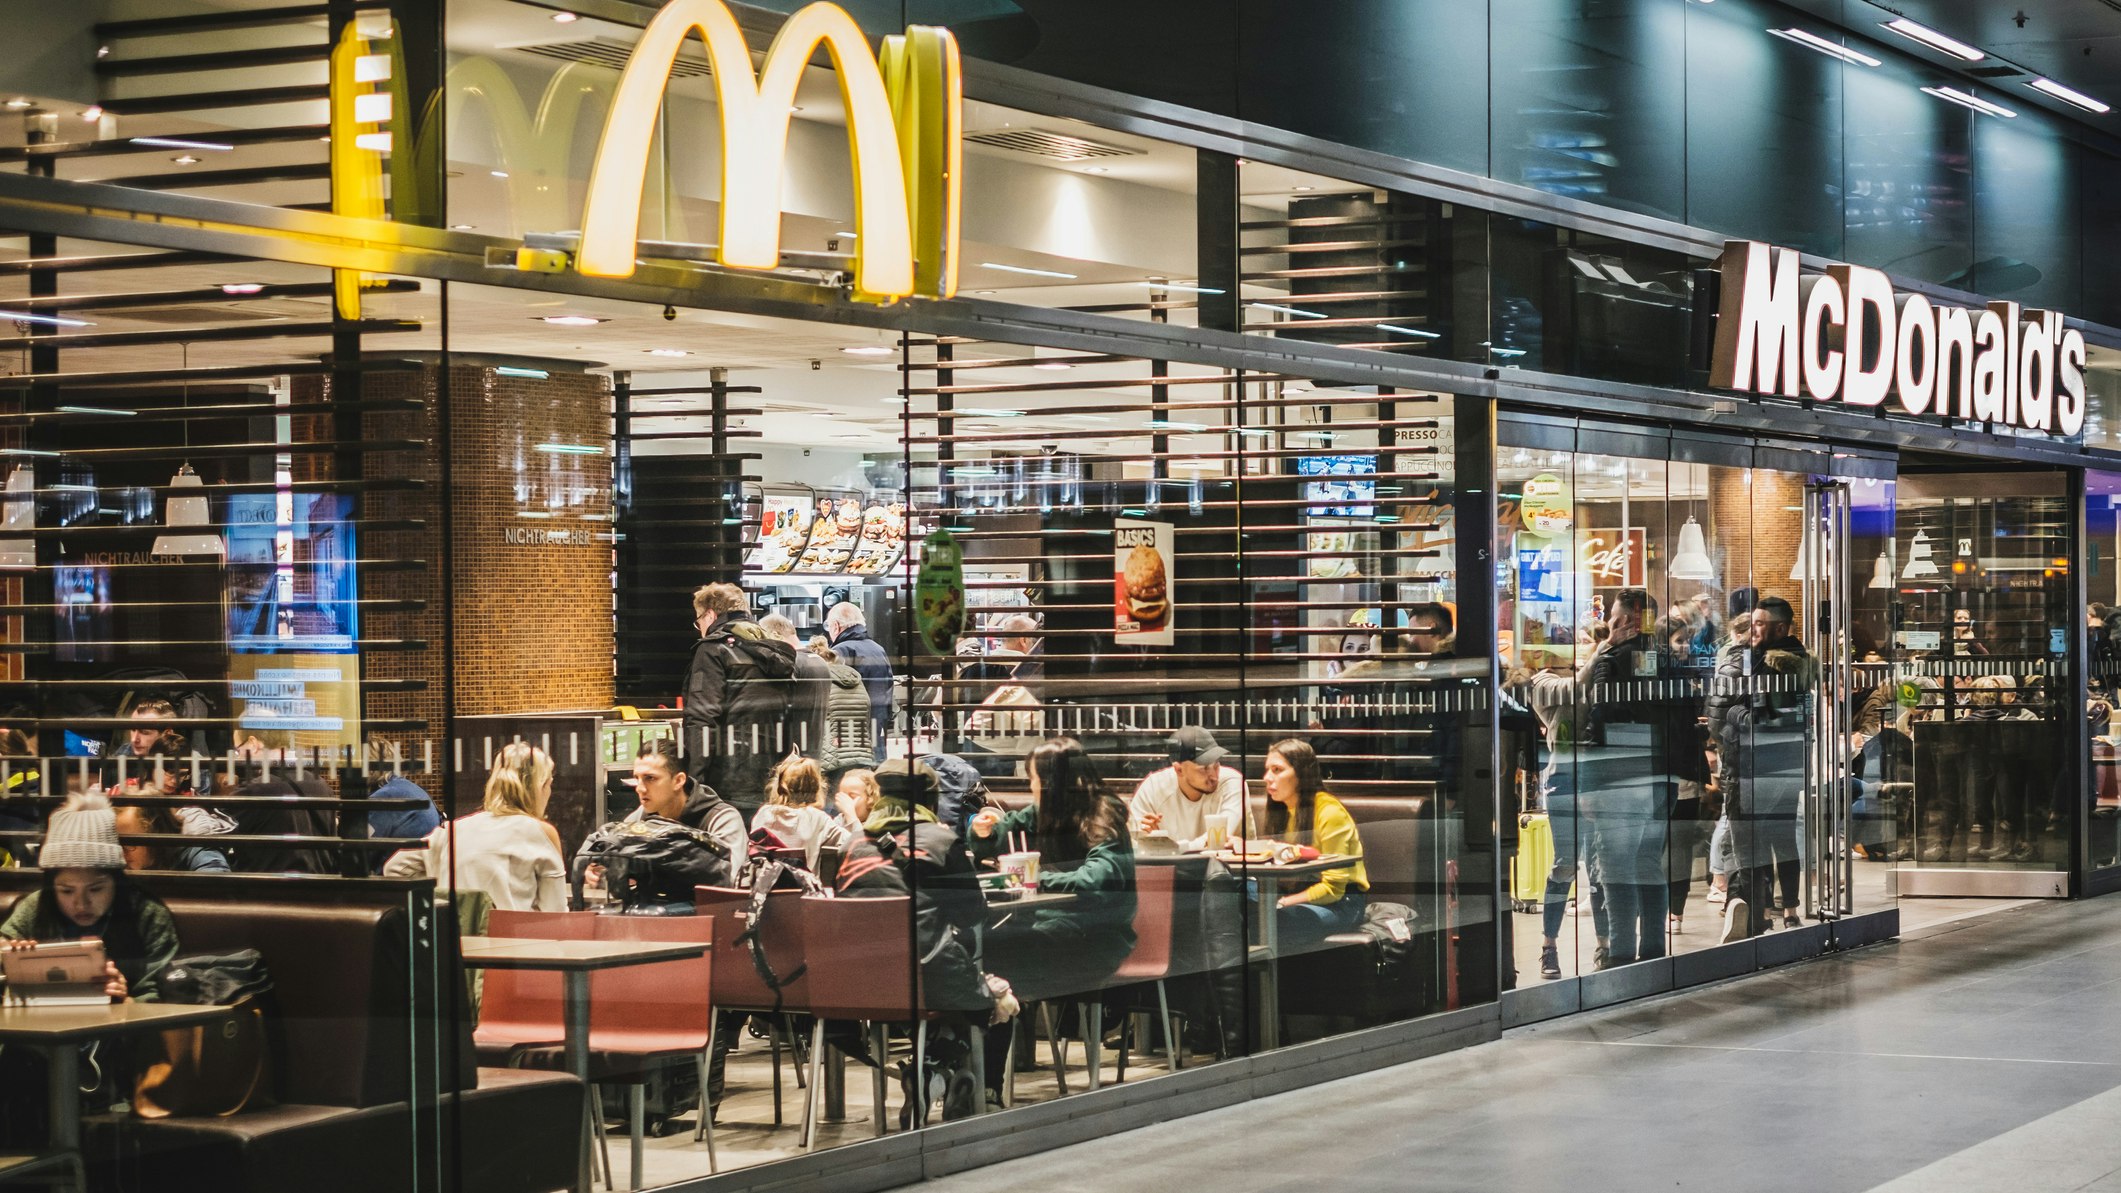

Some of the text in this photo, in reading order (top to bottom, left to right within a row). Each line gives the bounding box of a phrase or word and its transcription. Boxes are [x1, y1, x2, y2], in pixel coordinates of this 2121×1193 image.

[1730, 240, 2087, 436] McDonald's
[505, 528, 590, 545] NICHTRAUCHER
[1117, 529, 1154, 546] BASICS
[84, 552, 185, 566] NICHTRAUCHER
